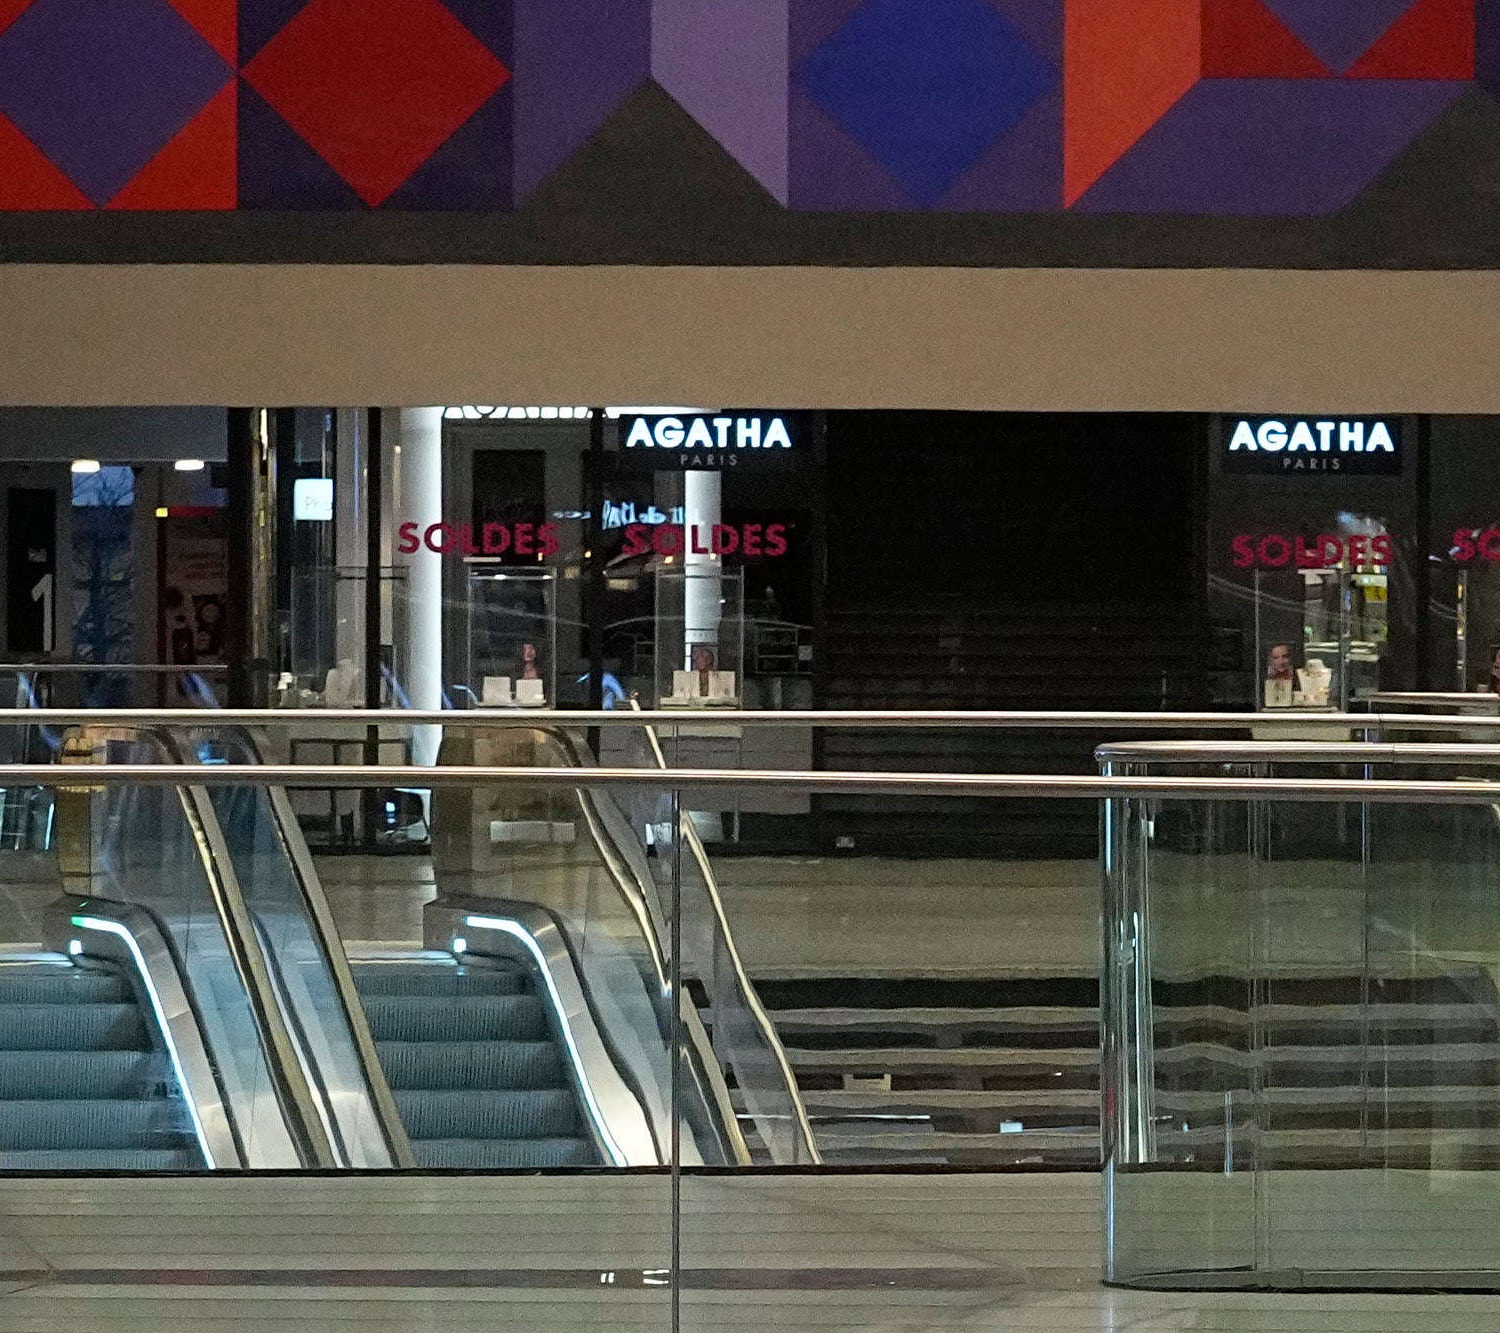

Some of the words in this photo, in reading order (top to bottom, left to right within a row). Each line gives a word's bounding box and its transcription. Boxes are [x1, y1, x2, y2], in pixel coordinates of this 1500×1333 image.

[626, 418, 792, 449] AGATHA
[1228, 421, 1395, 452] AGATHA
[680, 453, 739, 467] PARIS
[1283, 456, 1341, 470] PARIS
[398, 522, 561, 557] SOLDES
[622, 523, 789, 558] SOLDES
[1231, 534, 1394, 569] SOLDES
